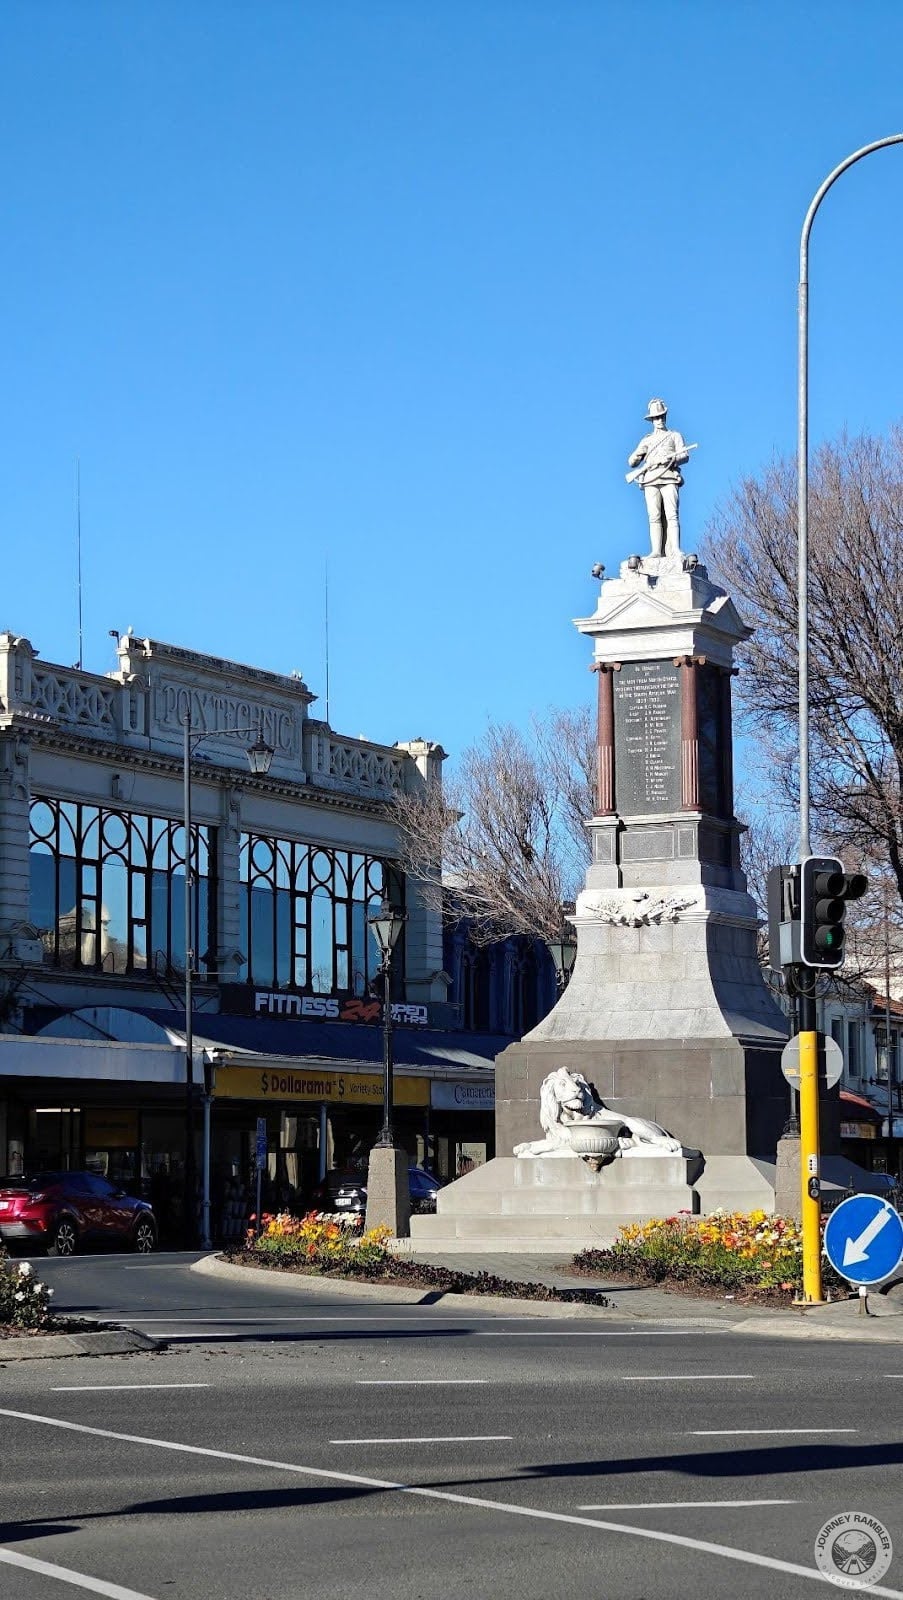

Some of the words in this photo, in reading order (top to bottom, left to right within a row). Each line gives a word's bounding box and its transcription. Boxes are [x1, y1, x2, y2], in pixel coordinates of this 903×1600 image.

[255, 992, 340, 1018] FITNESS
[340, 999, 380, 1022] 24
[403, 1014, 428, 1024] HRS
